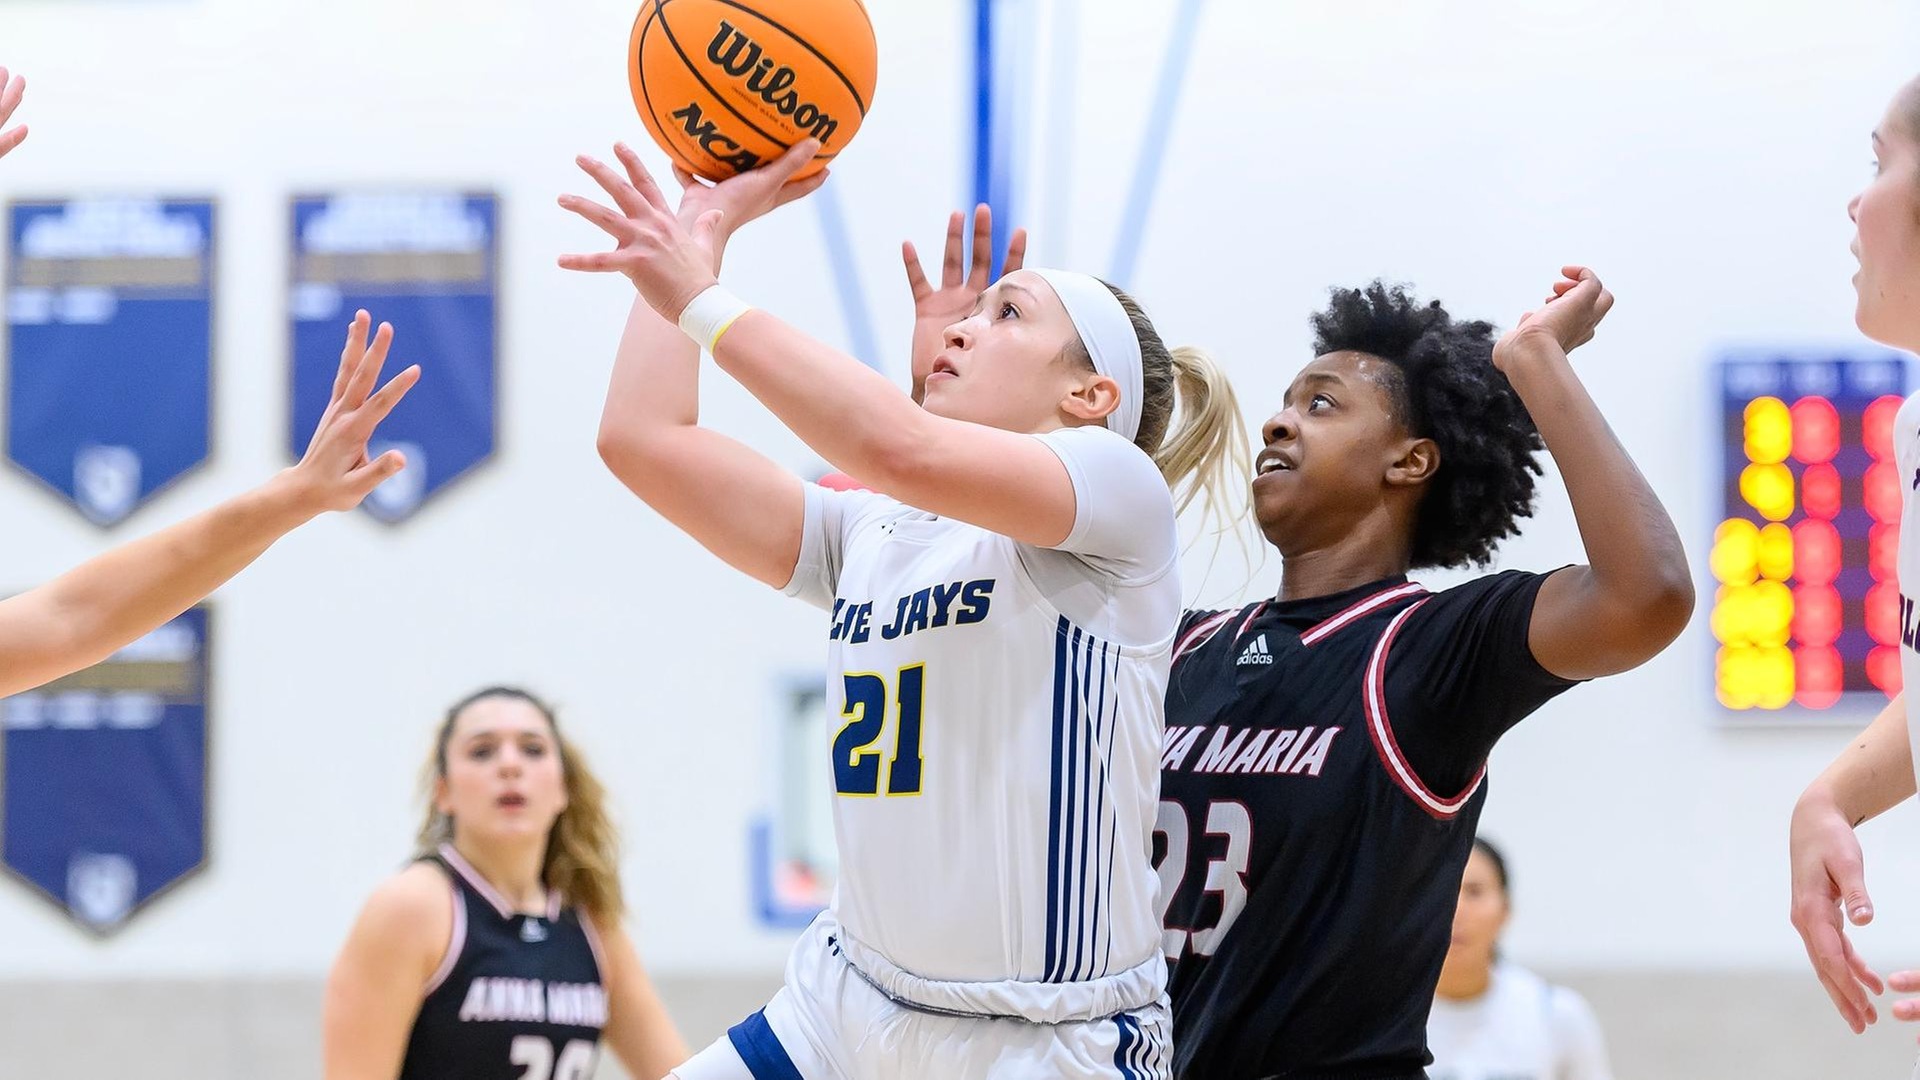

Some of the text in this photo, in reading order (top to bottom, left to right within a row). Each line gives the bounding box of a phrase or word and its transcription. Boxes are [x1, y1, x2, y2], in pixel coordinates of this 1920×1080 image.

[708, 20, 838, 143] Wilson
[673, 102, 772, 173] NCA
[830, 579, 995, 644] LUE JAYS
[1236, 652, 1273, 666] adidas
[832, 661, 926, 797] 21
[1193, 725, 1343, 776] MARIA
[1152, 799, 1253, 960] 23
